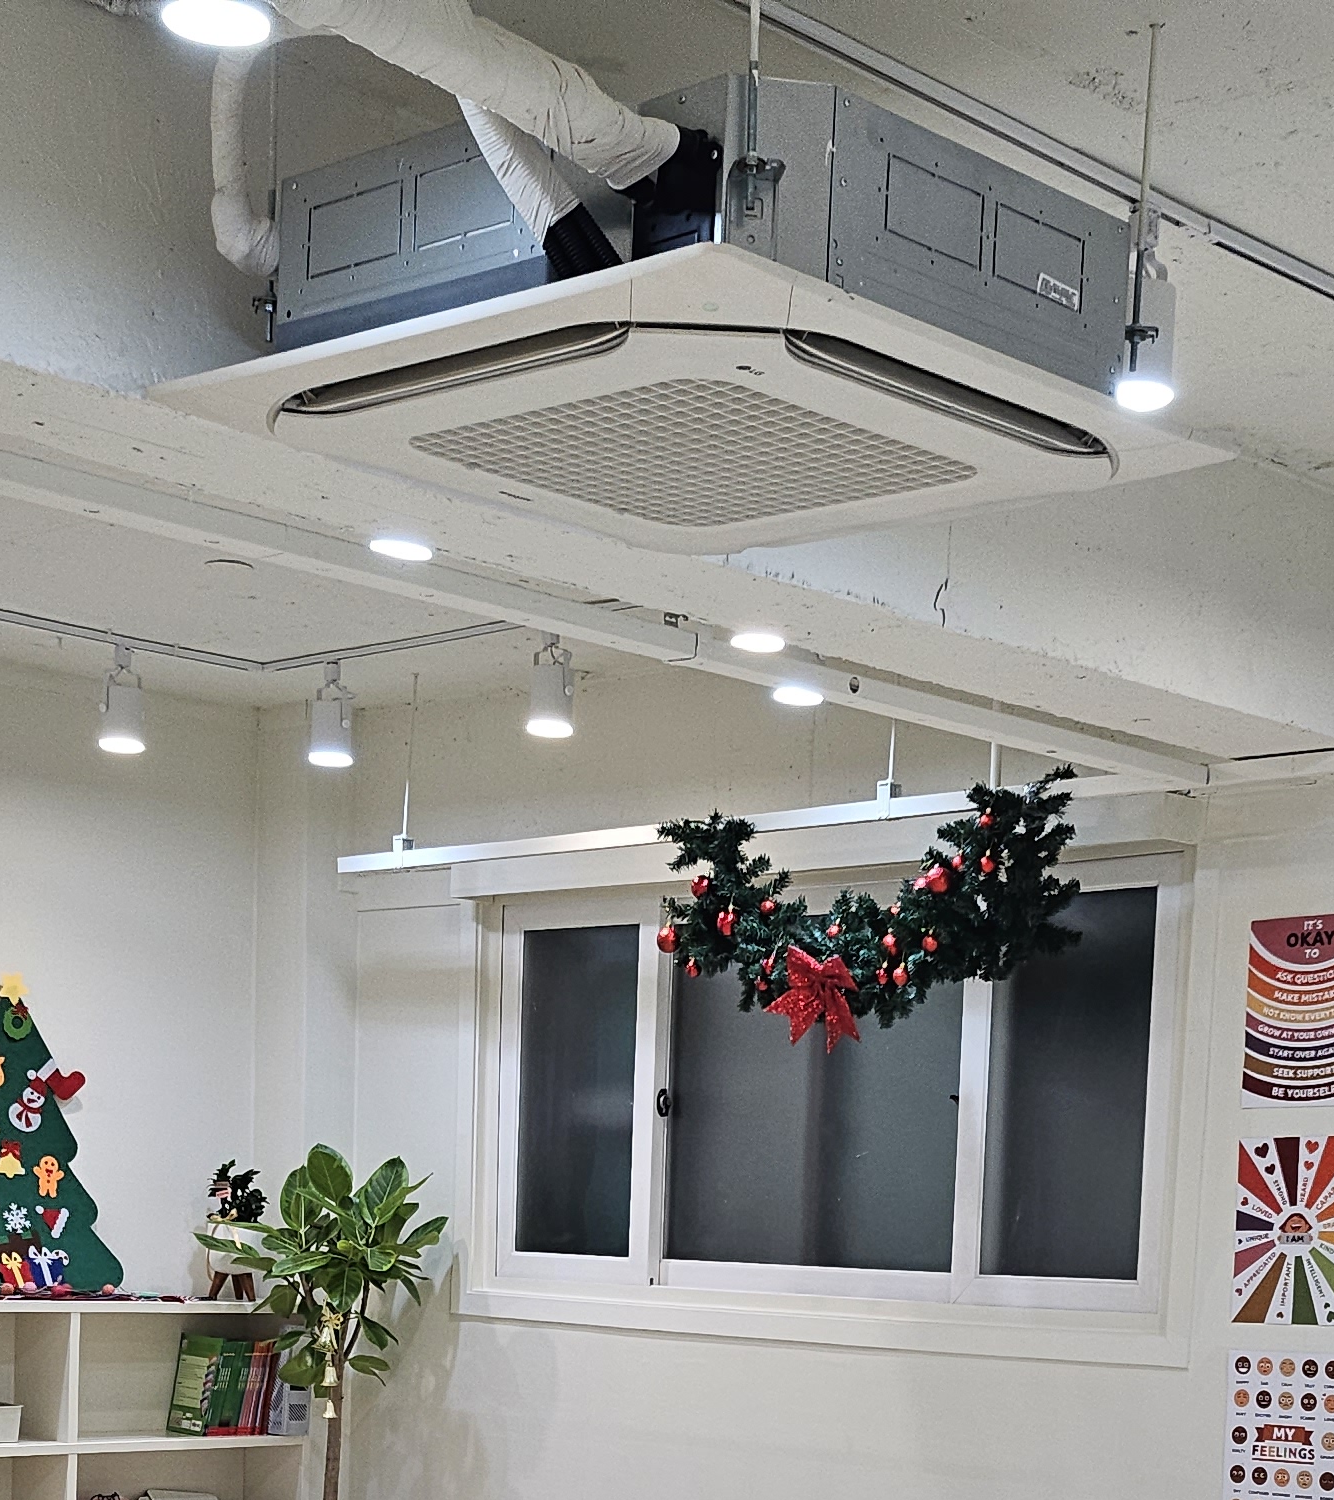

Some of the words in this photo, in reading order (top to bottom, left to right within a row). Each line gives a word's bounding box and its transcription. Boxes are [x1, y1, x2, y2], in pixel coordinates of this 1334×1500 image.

[1303, 919, 1323, 930] IT'S
[1286, 930, 1334, 947] OKAY
[1304, 948, 1320, 958] TO
[1275, 971, 1294, 983] ASK
[1273, 990, 1300, 1002] MAKE
[1263, 1006, 1279, 1018] NOT
[1257, 1024, 1282, 1038] GROW
[1281, 1031, 1293, 1039] AT
[1293, 1031, 1315, 1040] YOUR
[1269, 1047, 1293, 1058] START
[1293, 1049, 1316, 1059] OVER
[1273, 1067, 1295, 1078] SEEK
[1271, 1086, 1285, 1097] BE
[1251, 1204, 1273, 1219] LOVED
[1290, 1235, 1305, 1243] AM
[1319, 1243, 1334, 1255] KIND
[1243, 1252, 1276, 1288] APPRECIATED
[1280, 1261, 1293, 1307] IMPORTANT
[1305, 1258, 1326, 1299] INTELLIGENT
[1272, 1427, 1296, 1441] MY
[1251, 1444, 1315, 1460] FEELINGS
